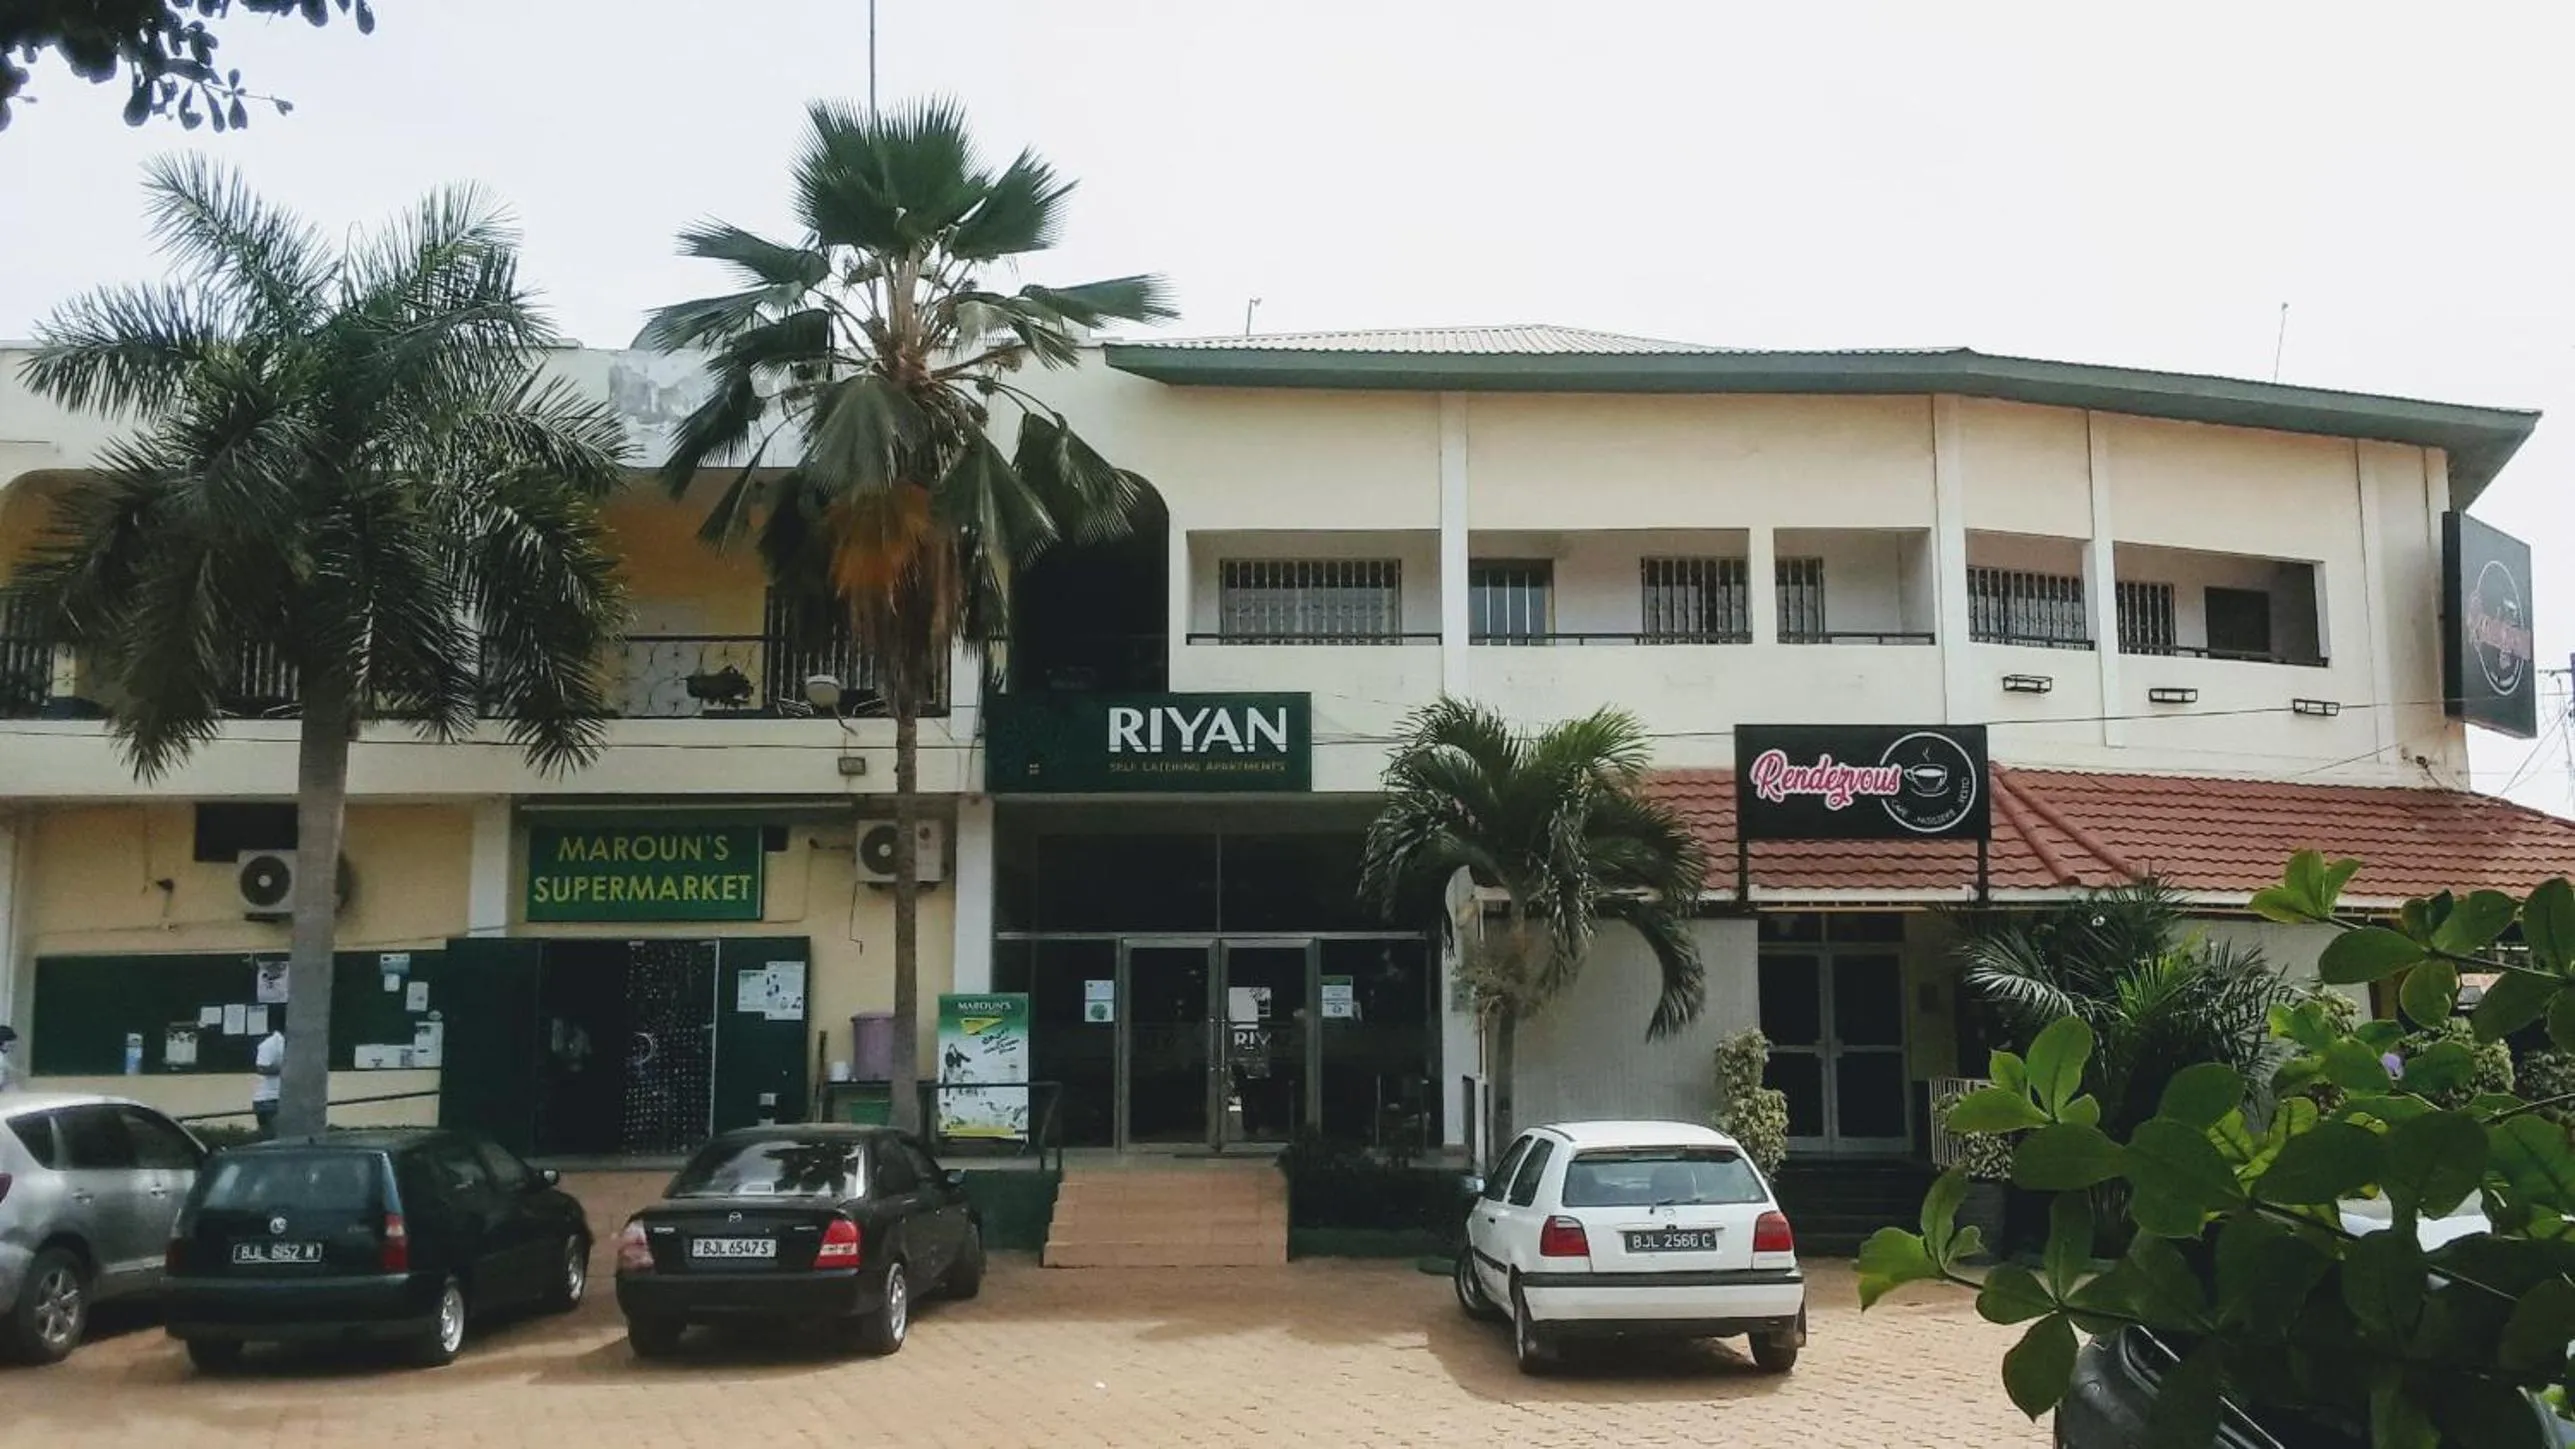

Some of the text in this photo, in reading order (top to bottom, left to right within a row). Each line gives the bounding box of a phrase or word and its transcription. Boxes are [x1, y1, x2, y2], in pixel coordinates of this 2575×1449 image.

[1108, 706, 1288, 753] RIYAN
[1751, 749, 1902, 810] Rendezvous
[558, 835, 729, 862] MAROUN'S
[533, 875, 751, 903] SUPERMARKET
[1632, 1235, 1660, 1249] BJL
